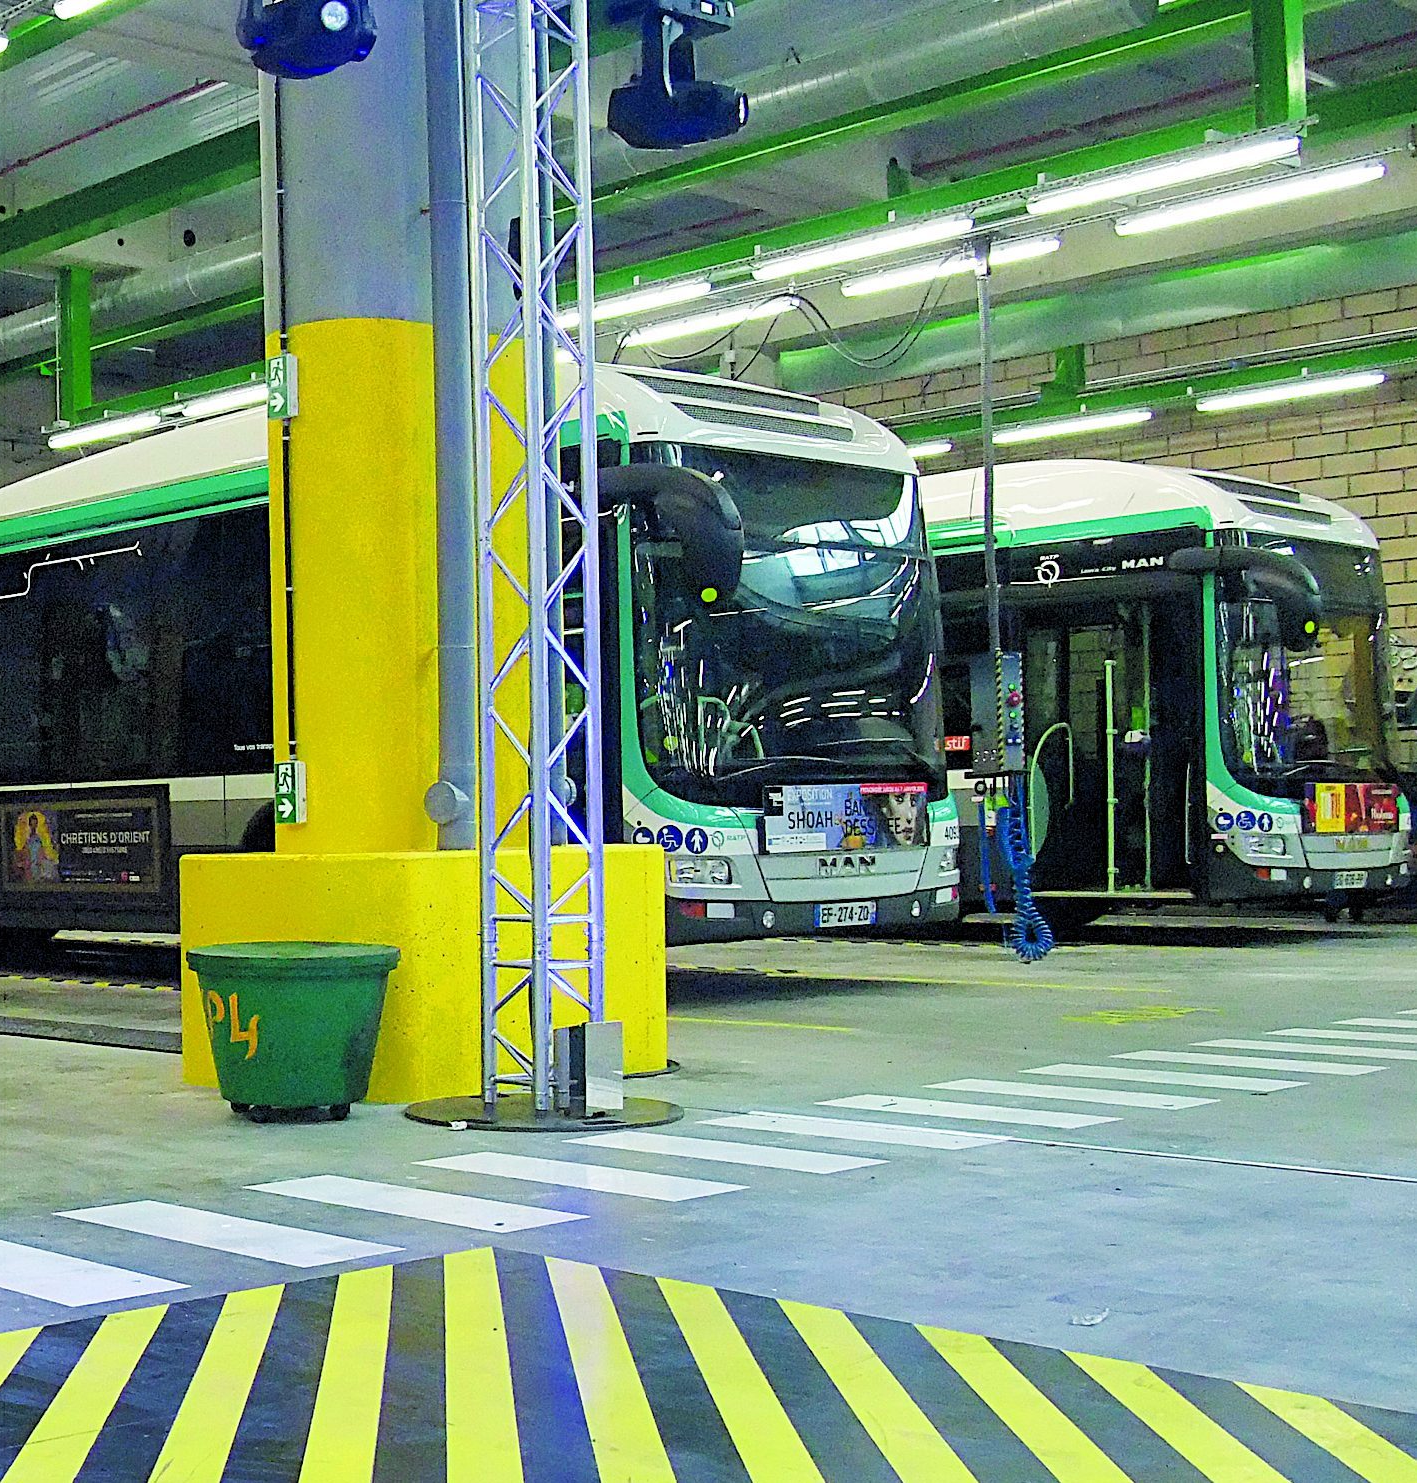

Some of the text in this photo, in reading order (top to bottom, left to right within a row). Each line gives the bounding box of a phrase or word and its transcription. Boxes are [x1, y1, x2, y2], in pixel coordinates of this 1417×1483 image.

[1121, 556, 1164, 569] MAN
[946, 737, 969, 749] stif
[788, 811, 834, 829] SHOAH
[110, 831, 151, 844] D'ORIENT
[817, 855, 876, 877] MAN
